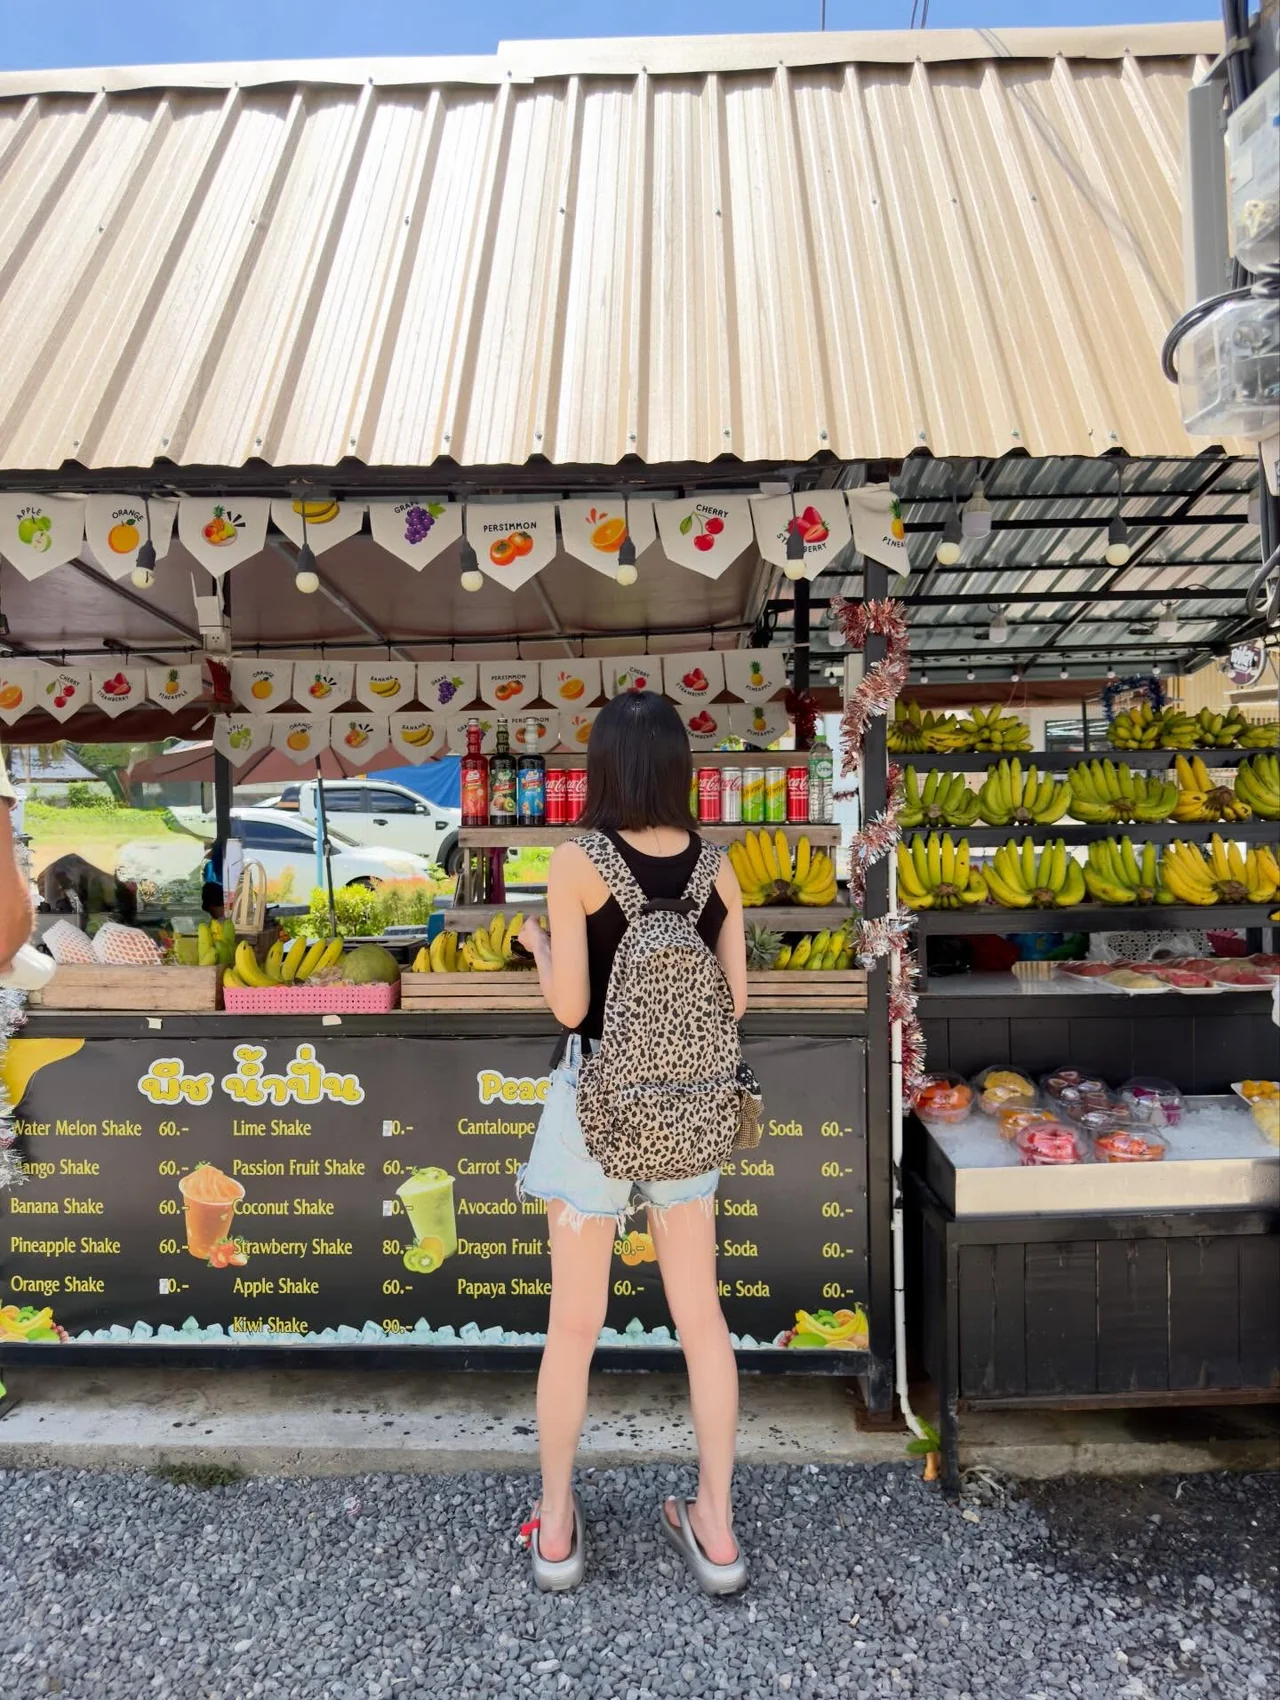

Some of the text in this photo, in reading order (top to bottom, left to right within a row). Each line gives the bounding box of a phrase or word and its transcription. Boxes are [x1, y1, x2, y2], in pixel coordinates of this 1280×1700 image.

[16, 507, 42, 520] APPLE
[112, 509, 144, 521] ORANGE
[696, 504, 729, 518] CHERRY
[483, 521, 537, 533] PERSIMMON
[60, 674, 80, 686] CHERRY
[629, 667, 650, 677] CHERRY
[675, 682, 707, 697] STRAWBERRY
[745, 681, 773, 692] PINEAPPLE
[158, 690, 188, 701] PINEAPPLE
[746, 727, 776, 738] PINEAPPLE
[478, 1071, 550, 1104] Peac
[56, 1120, 96, 1136] Melon
[102, 1120, 142, 1136] Shake
[233, 1120, 266, 1136] Lime
[271, 1120, 311, 1136] Shake
[458, 1119, 535, 1139] Cantaloupe
[769, 1120, 803, 1136] Soda
[60, 1159, 99, 1175] Shake
[233, 1160, 285, 1175] Passion
[290, 1159, 320, 1175] Fruit
[325, 1159, 365, 1175] Shake
[458, 1159, 501, 1175] Carrot
[741, 1160, 774, 1176] Soda
[11, 1198, 59, 1214] Banana
[64, 1198, 104, 1214] Shake
[233, 1199, 289, 1215] Coconut
[294, 1199, 334, 1215] Shake
[458, 1199, 517, 1215] Avocado
[724, 1200, 758, 1216] Soda
[11, 1237, 76, 1257] Pineapple
[81, 1237, 120, 1253] Shake
[233, 1238, 307, 1258] Strawberry
[312, 1238, 352, 1254] Shake
[458, 1238, 506, 1259] Dragon
[512, 1238, 542, 1255] Fruit
[724, 1240, 758, 1256] Soda
[11, 1275, 60, 1296] Orange
[65, 1276, 104, 1292] Shake
[233, 1278, 274, 1298] Apple
[279, 1278, 319, 1294] Shake
[457, 1279, 506, 1299] Papaya
[511, 1279, 552, 1295] Shake
[736, 1280, 769, 1297] Soda
[233, 1317, 263, 1333] Kiwi
[267, 1317, 308, 1333] Shake
